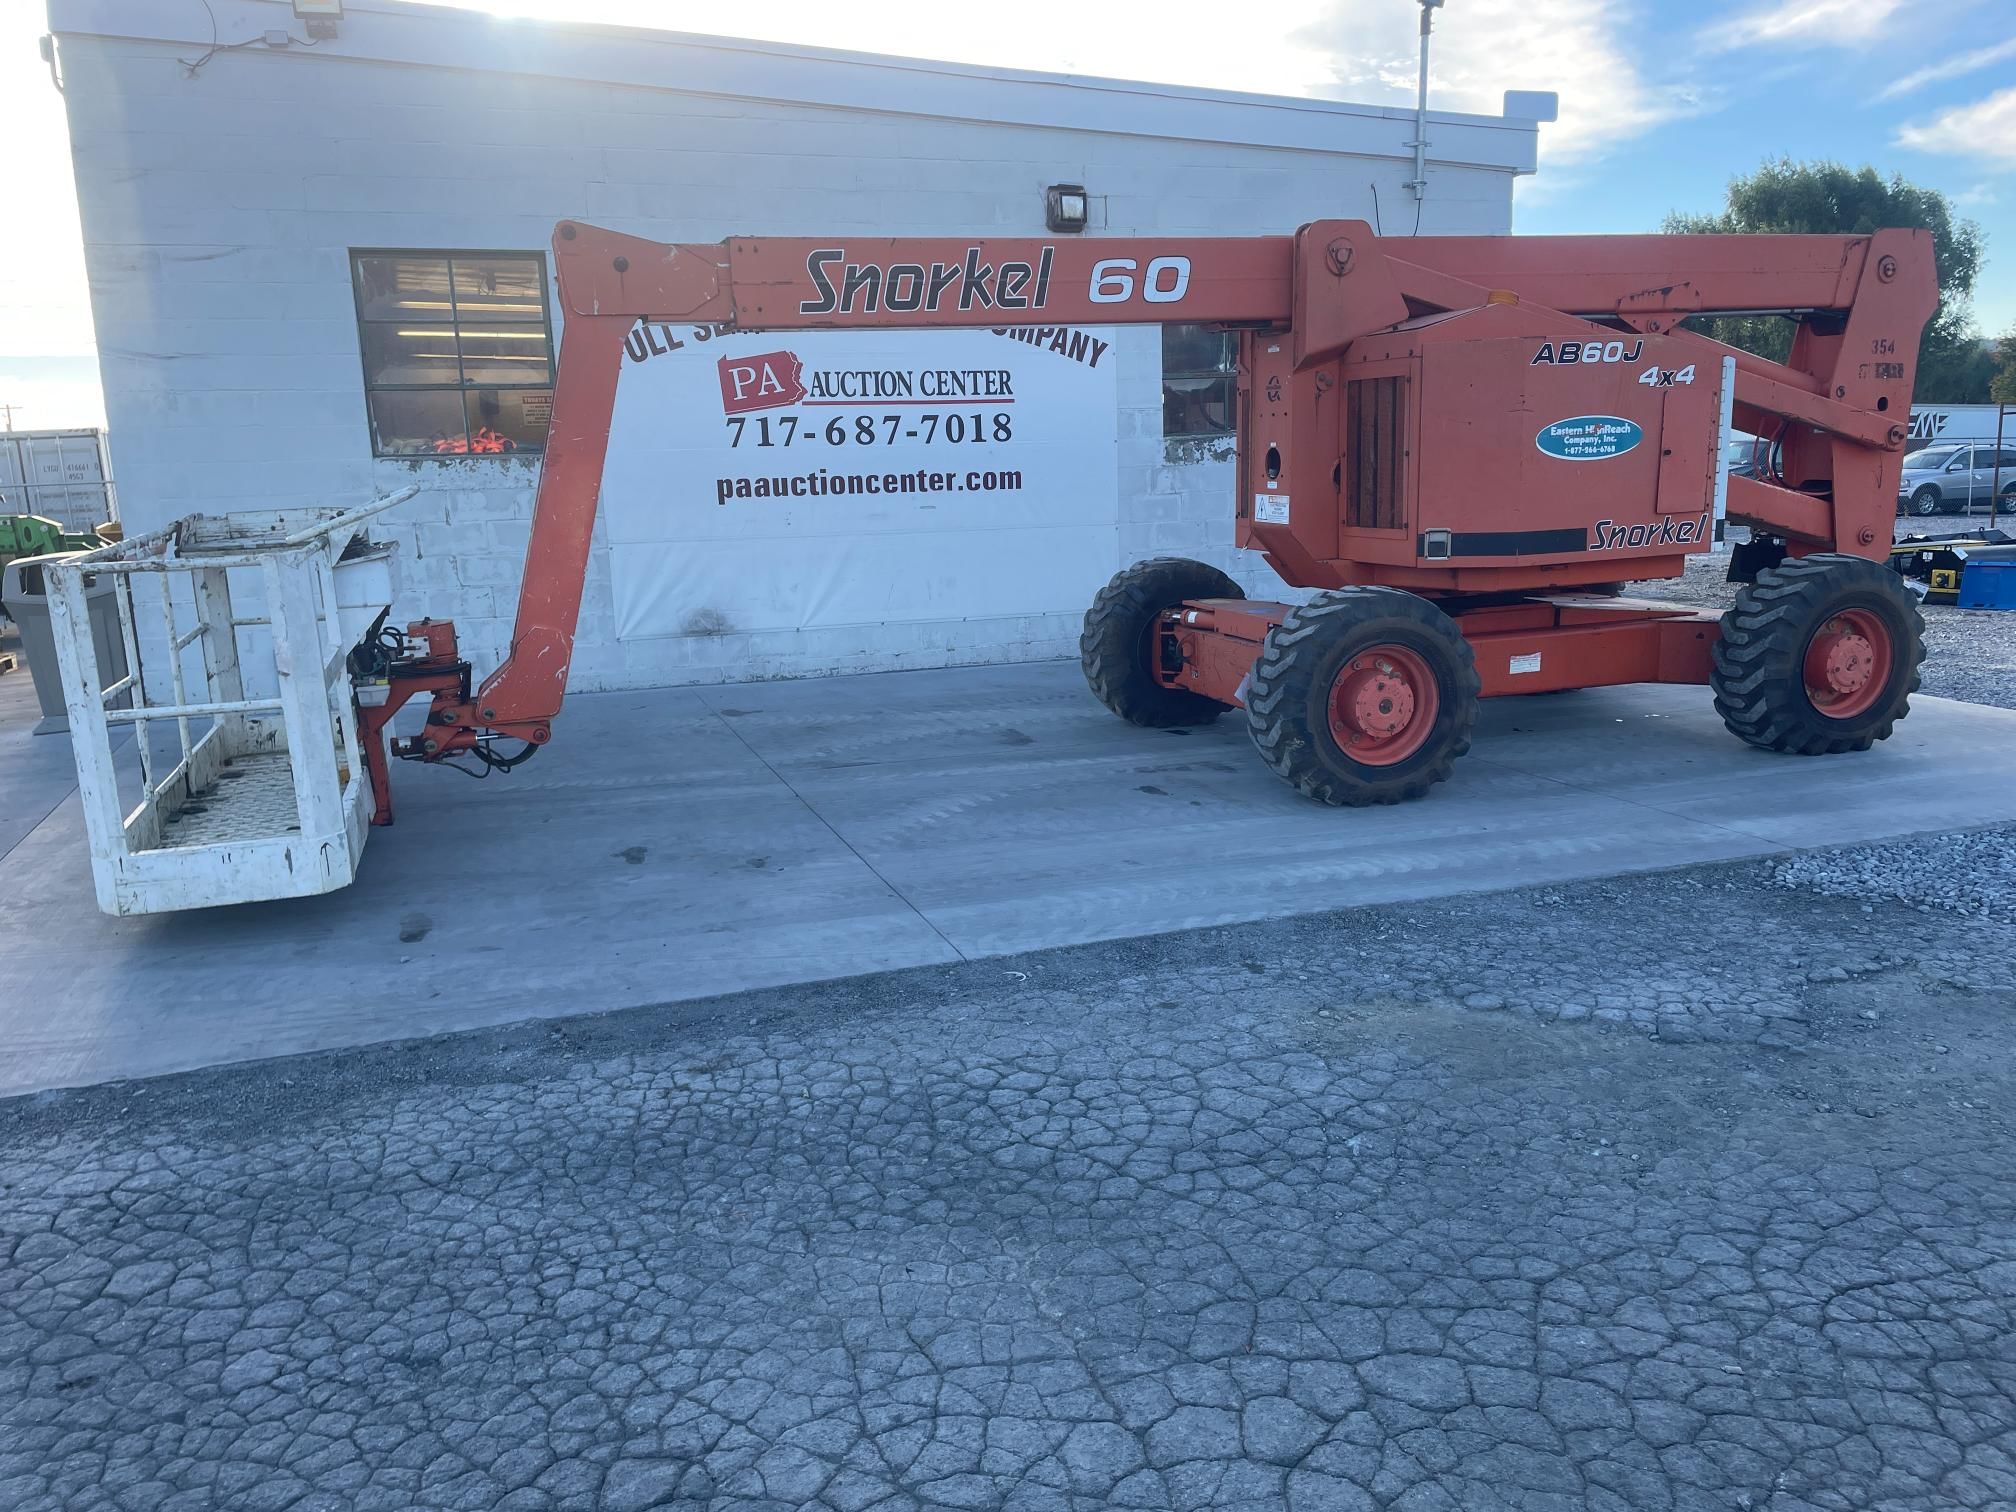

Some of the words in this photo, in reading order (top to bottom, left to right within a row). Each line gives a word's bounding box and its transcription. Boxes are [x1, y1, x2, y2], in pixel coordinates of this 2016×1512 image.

[800, 246, 1055, 314] Snorkel
[1088, 256, 1192, 304] 60
[622, 325, 685, 363] ULL
[1530, 340, 1644, 365] AB60J
[1871, 338, 1896, 355] 354
[728, 362, 786, 400] PA
[809, 371, 913, 398] AUCTION
[919, 369, 1014, 396] CENTER
[1638, 364, 1696, 387] 4x4
[726, 413, 1013, 448] 717-687-7018
[1550, 426, 1583, 436] Eastern
[1563, 436, 1602, 445] Company,
[1603, 435, 1617, 443] Inc.
[1564, 446, 1616, 454] 1-877-266-6768
[716, 468, 1022, 504] paauctioncenter.com
[1588, 512, 1709, 551] Snorkel
